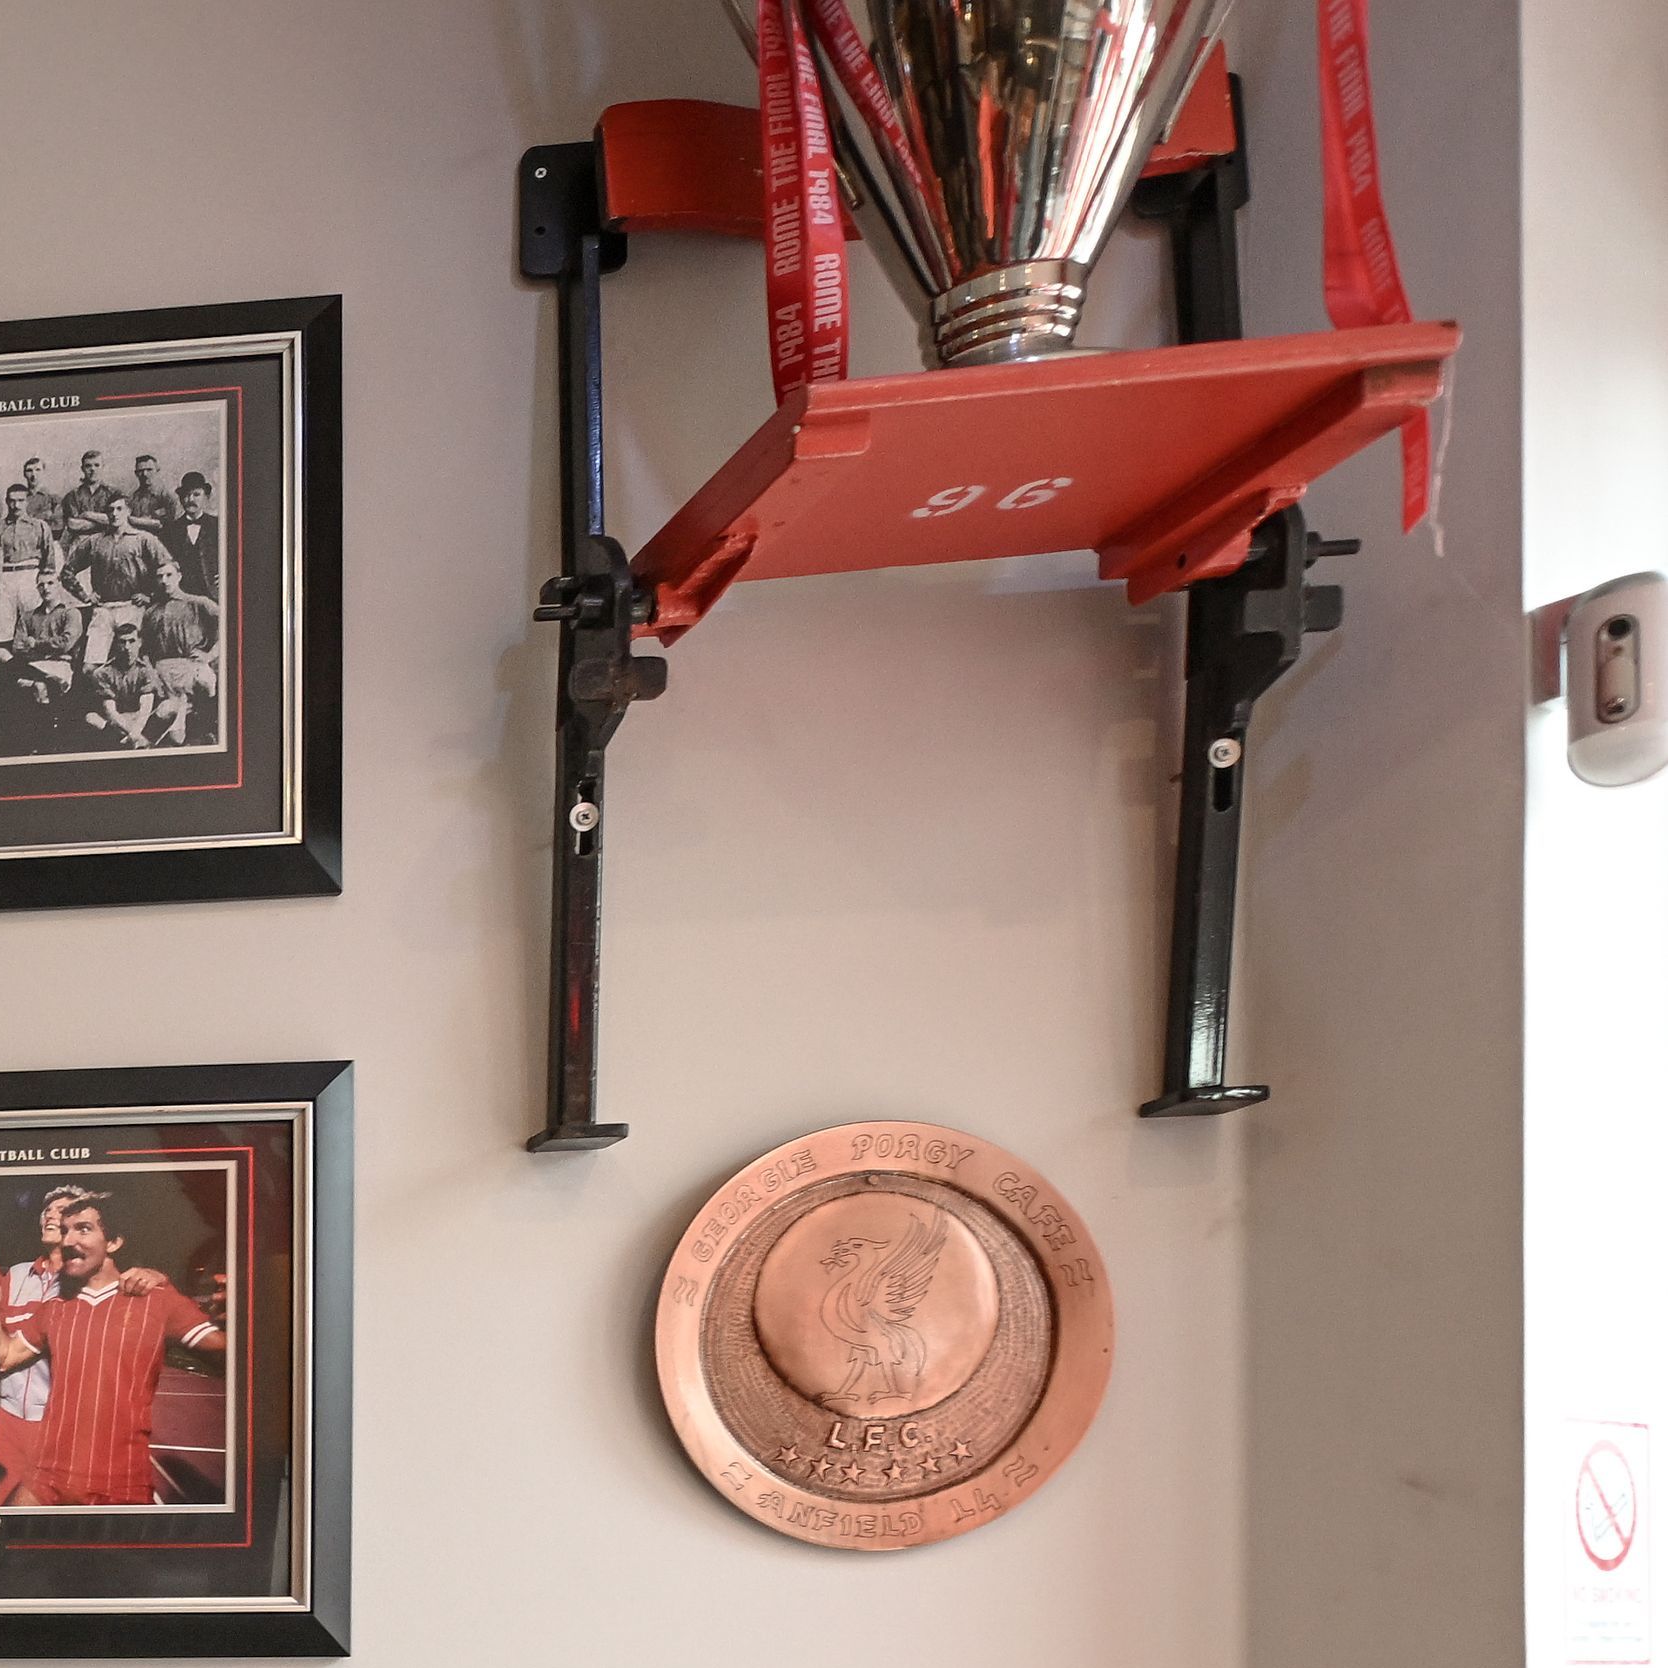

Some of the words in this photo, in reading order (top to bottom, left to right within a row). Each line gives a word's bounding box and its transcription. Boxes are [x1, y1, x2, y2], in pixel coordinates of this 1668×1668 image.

[767, 74, 796, 137] FINAL
[803, 90, 829, 160] FINAL
[771, 141, 797, 193] THE
[808, 169, 835, 226] 1984
[773, 196, 801, 277] ROME
[813, 253, 841, 333] ROME
[778, 302, 804, 371] 1984
[40, 394, 81, 411] CLUB
[911, 475, 1074, 519] 96
[50, 1145, 92, 1161] CLUB
[691, 1149, 818, 1264] GEORGIE
[850, 1132, 975, 1170] PORGY
[993, 1170, 1078, 1253] CAFE
[757, 1488, 925, 1539] ANFIELD
